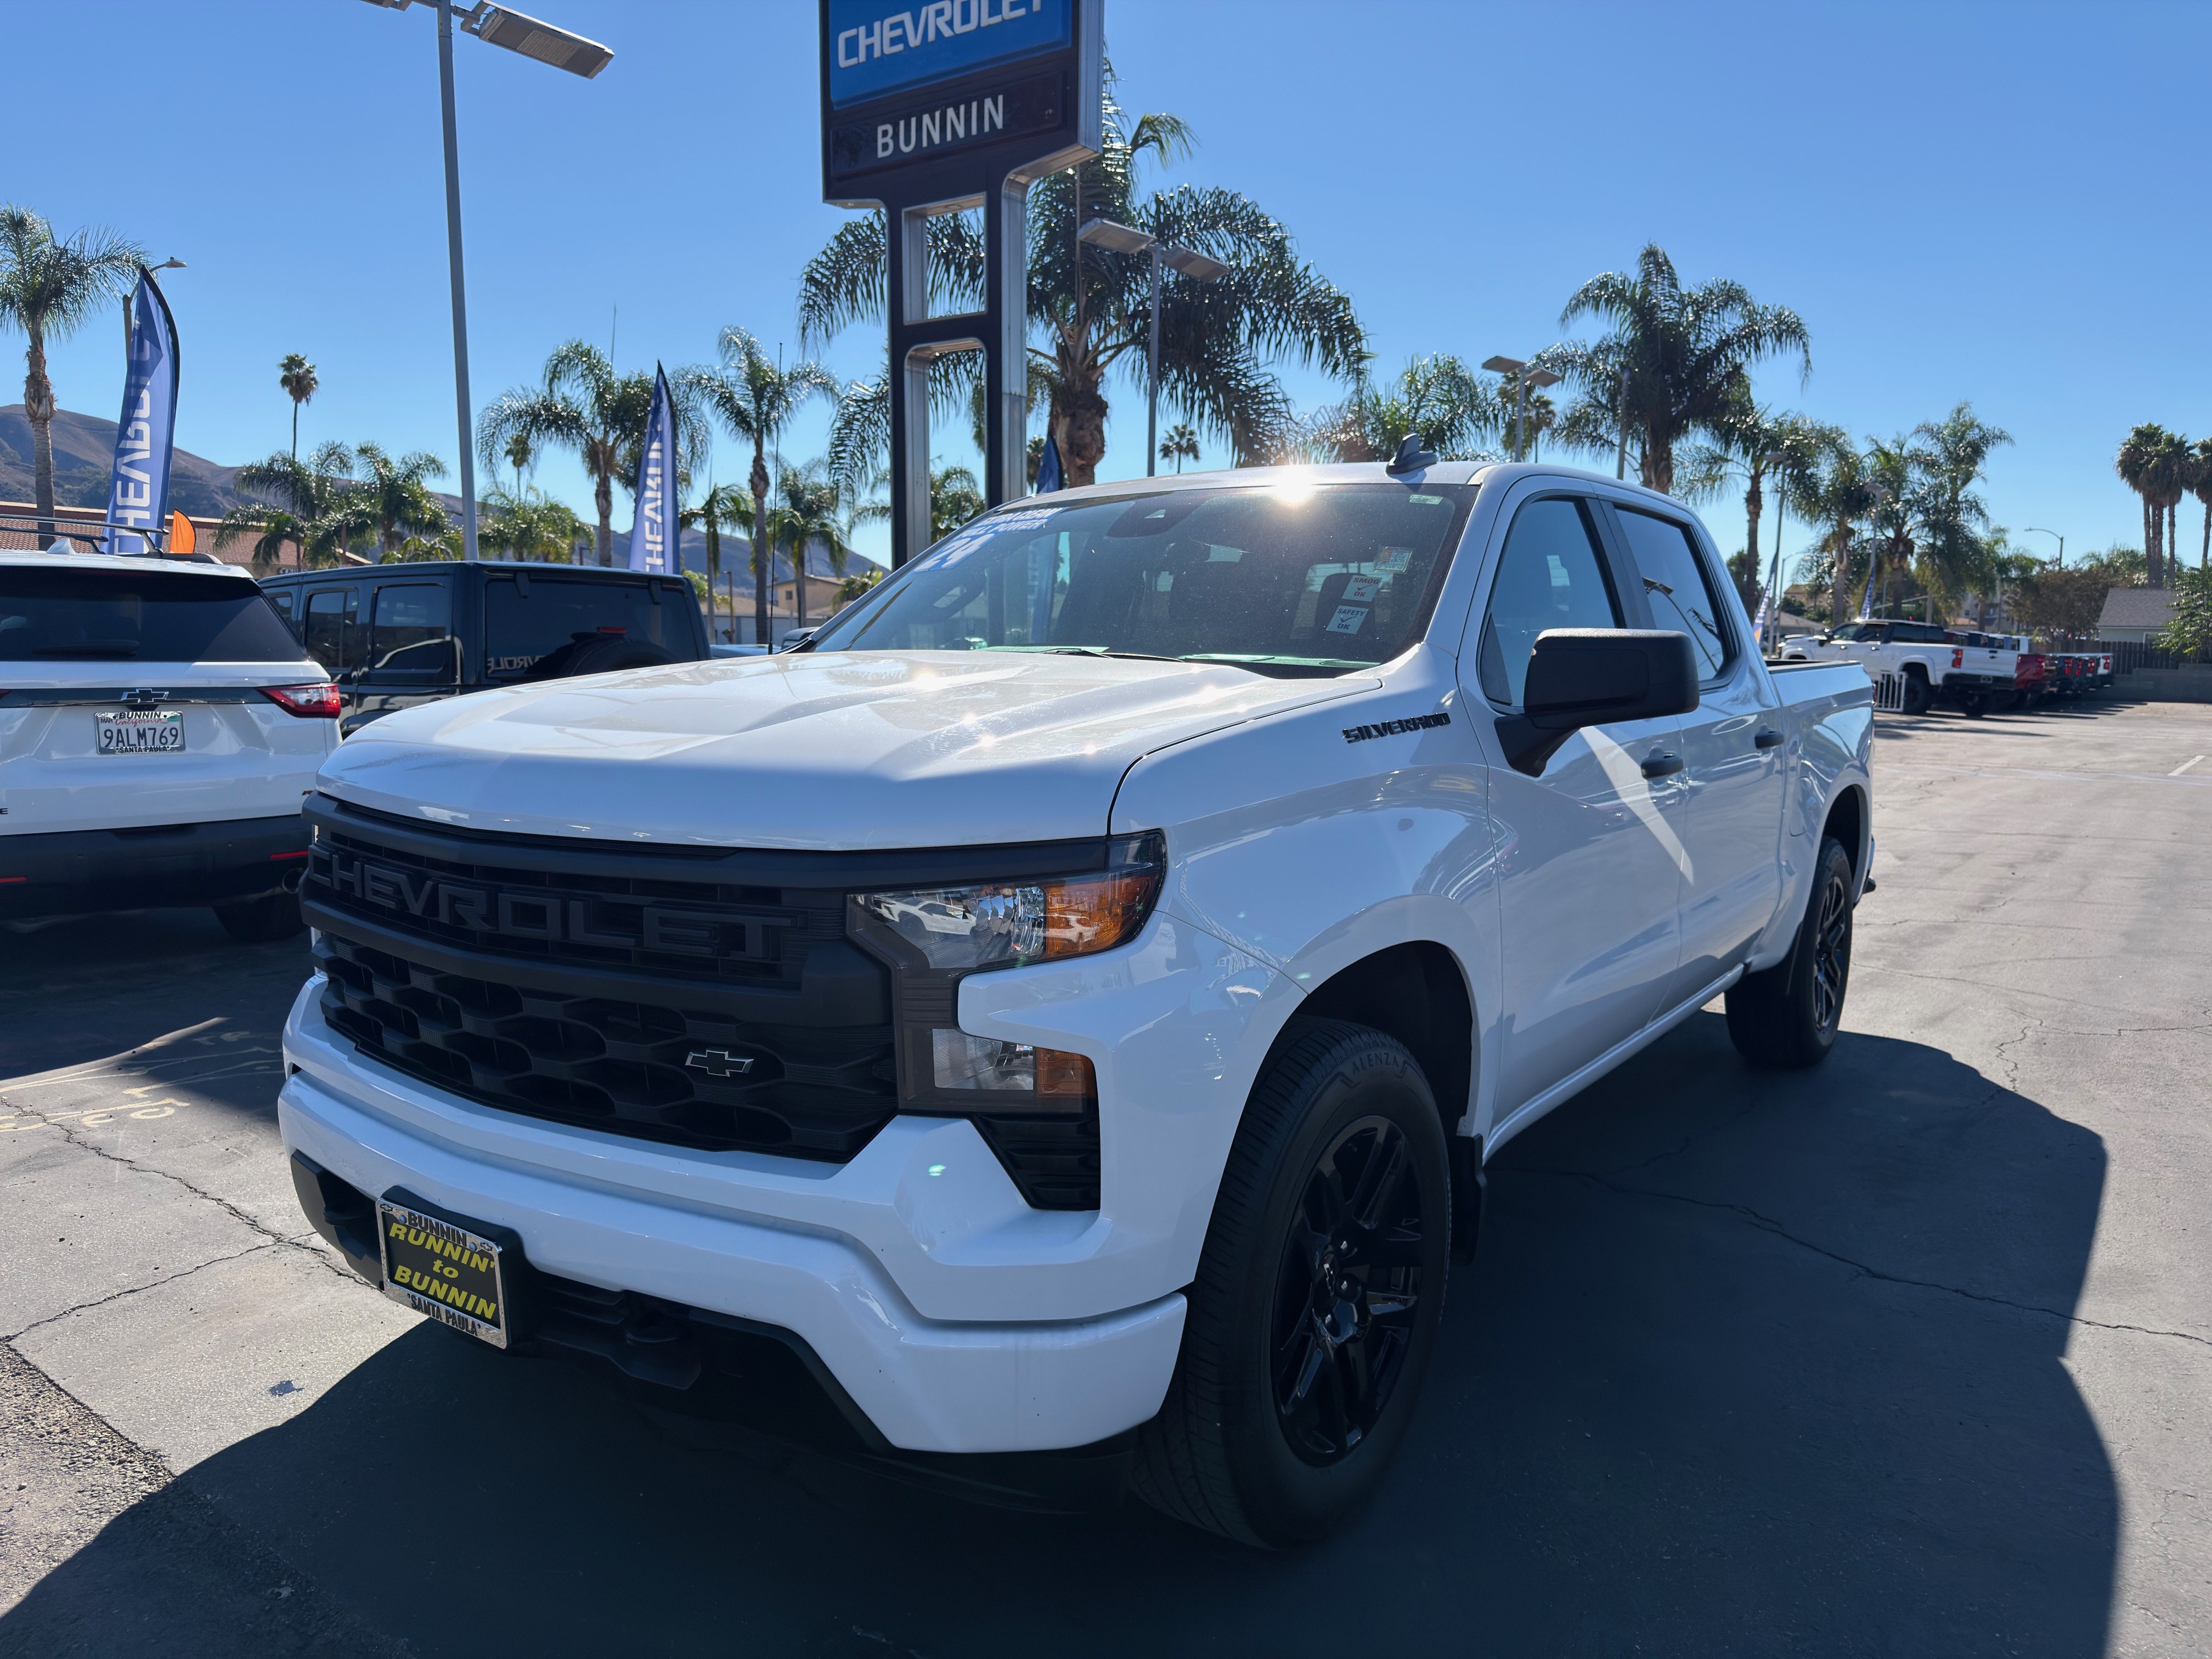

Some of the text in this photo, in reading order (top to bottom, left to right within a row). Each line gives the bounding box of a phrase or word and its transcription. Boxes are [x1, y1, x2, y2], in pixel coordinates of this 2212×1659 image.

[878, 94, 1003, 158] BUNNIN
[987, 518, 1048, 533] POWER
[1337, 608, 1365, 617] SAFETY
[104, 727, 178, 748] 9ALM769
[115, 719, 168, 728] California
[1342, 713, 1451, 744] SILVERADO
[308, 844, 798, 959] CHEVROLET
[1352, 1052, 1399, 1075] ALENZA
[408, 1211, 467, 1247] BUNNIN
[389, 1223, 494, 1273] RUNNIN'
[433, 1260, 459, 1278] to
[394, 1265, 496, 1319] BUNNIN
[411, 1295, 478, 1336] SANTA PAULA
